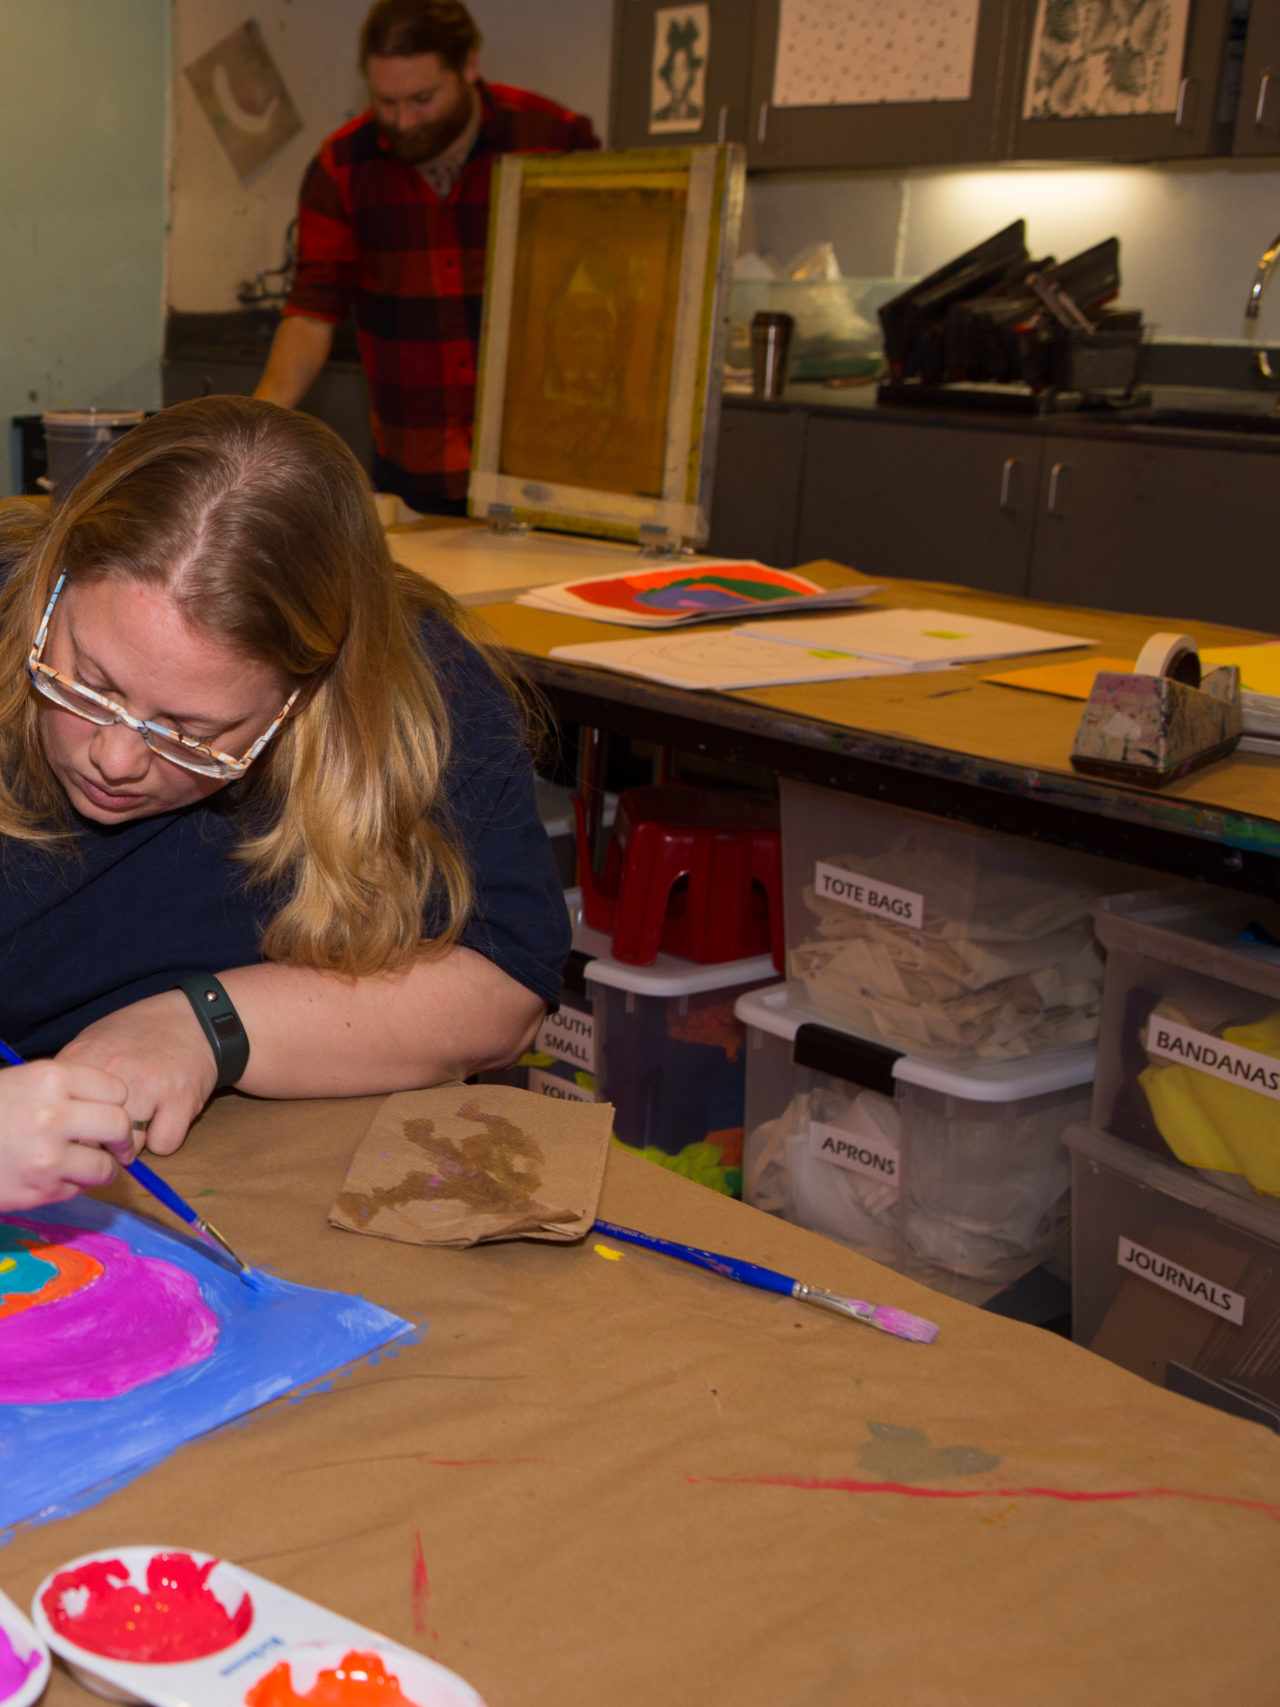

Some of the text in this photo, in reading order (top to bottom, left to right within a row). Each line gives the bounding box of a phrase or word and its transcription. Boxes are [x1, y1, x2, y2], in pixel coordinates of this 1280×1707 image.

[823, 874, 913, 919] TOTE BAGS
[545, 1033, 589, 1063] SMALL
[1156, 1031, 1280, 1090] BANDANAS
[822, 1137, 895, 1175] APRONS
[1125, 1247, 1232, 1311] JOURNALS
